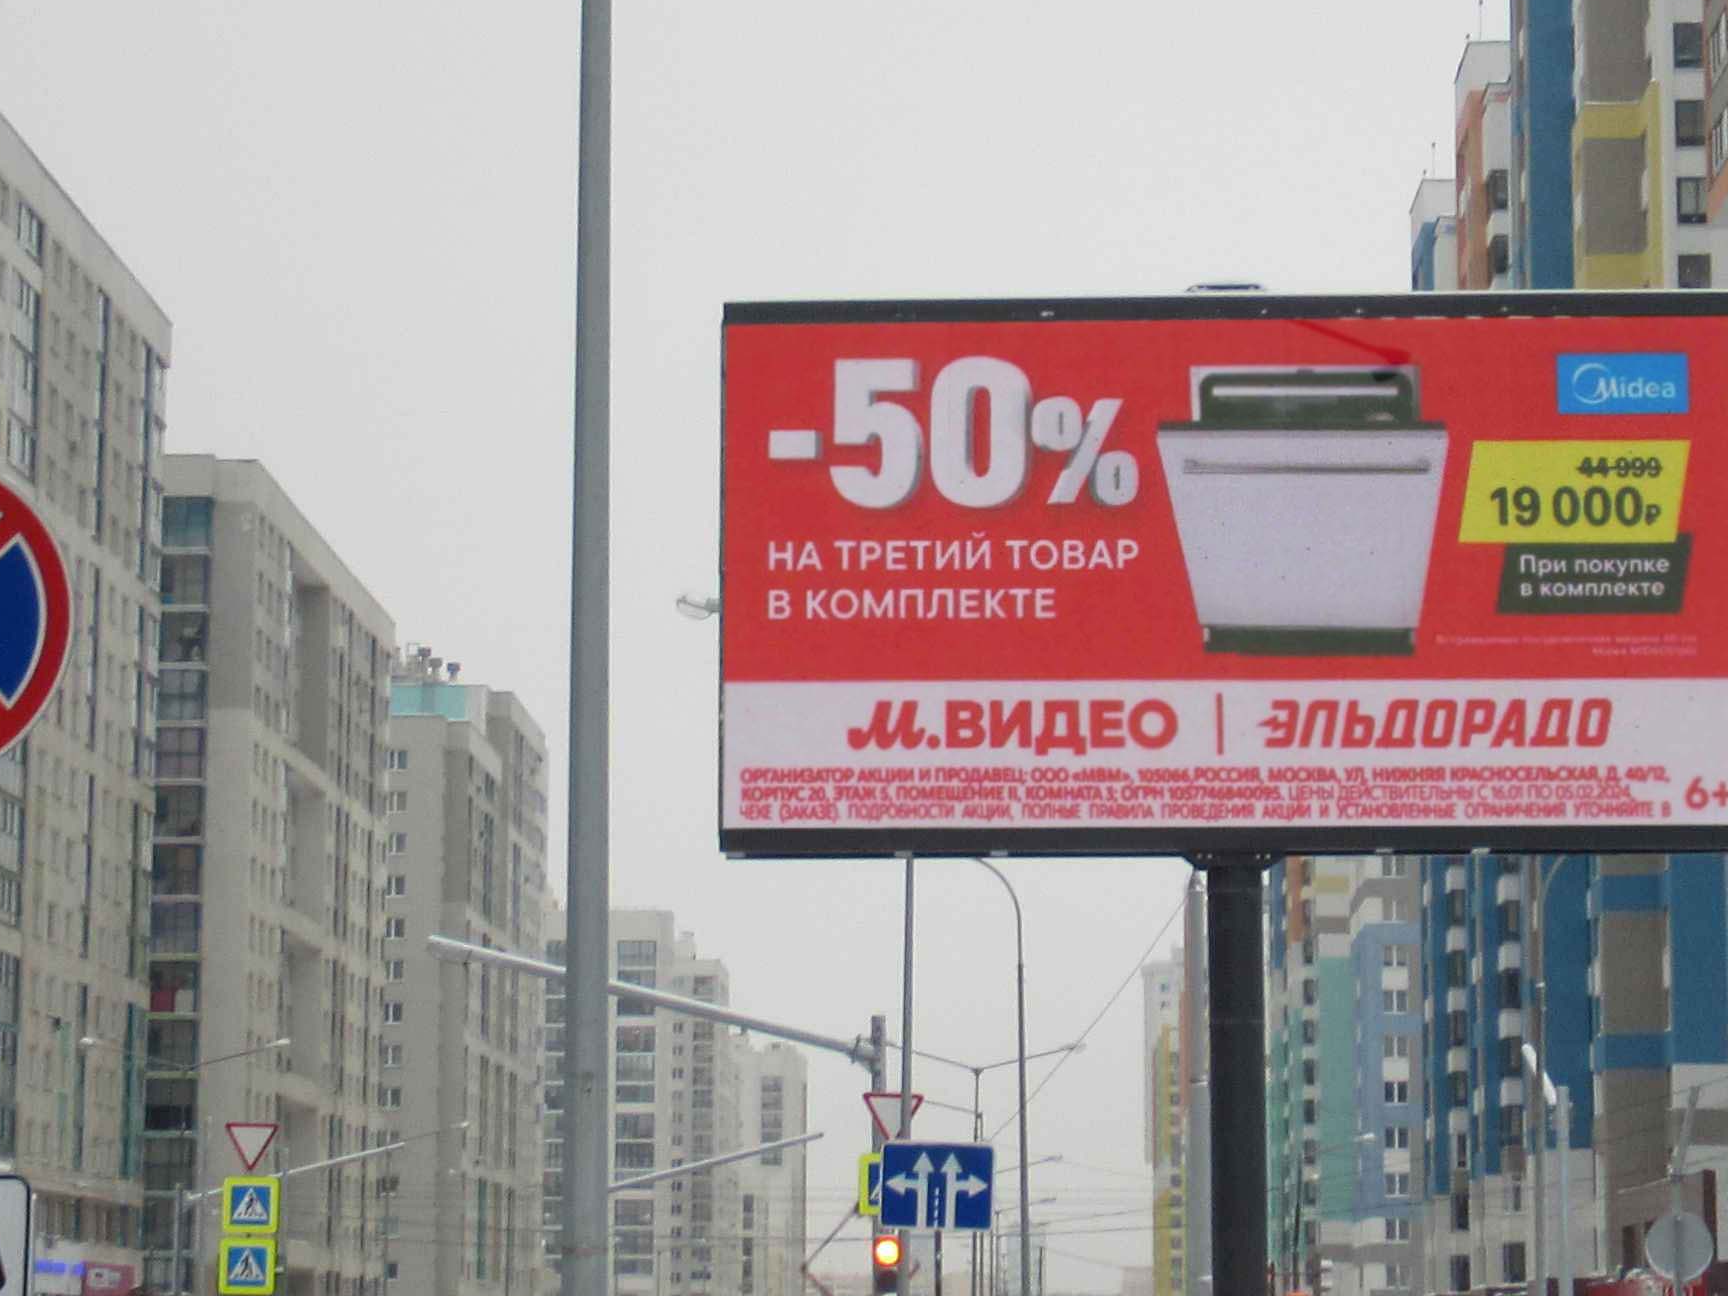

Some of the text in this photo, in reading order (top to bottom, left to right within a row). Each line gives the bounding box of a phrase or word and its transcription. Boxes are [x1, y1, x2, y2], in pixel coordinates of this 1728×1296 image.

[1590, 375, 1677, 401] Midea
[768, 355, 1140, 509] -50%
[768, 532, 1140, 571] НА ТРЕТИЙ ТОВАР
[1520, 555, 1670, 578] При покупке
[1519, 582, 1666, 598] в комплекте
[768, 587, 1057, 620] В КОМПЛЕКТЕ
[1255, 697, 1613, 750] ЭЛЬДОРАДО
[740, 767, 854, 783] ОРГАНИЗАТОР
[857, 767, 915, 786] АКЦИИ
[918, 767, 931, 783] И
[1030, 766, 1069, 783] ООО
[1268, 766, 1341, 784] МОСКВА,
[1373, 766, 1445, 782] НИЖНЯЯ
[1450, 765, 1602, 783] КРАСНОСЕЛЬСКАЯ,
[741, 785, 807, 801] КОРПУС
[832, 785, 876, 801] ЭТАЖ
[897, 785, 1003, 802] ПОМЕЩЕНИЕ
[1026, 785, 1102, 801] КОМНАТА
[1122, 785, 1164, 801] ОГРН
[1288, 784, 1333, 801] ЦЕНЫ
[1337, 784, 1472, 801] ДЕЙСТВИТЕЛЬНЫ
[1477, 784, 1489, 800] С
[1528, 784, 1552, 800] ПО
[740, 804, 771, 819] ЧЕКЕ
[848, 804, 954, 819] ПОДРОБНОСТИ
[1022, 803, 1081, 819] ПОЛНЫЕ
[1089, 803, 1154, 818] ПРАВИЛА
[1161, 803, 1255, 819] ПРОВЕДЕНИЯ
[1262, 803, 1311, 820] АКЦИИ
[1336, 802, 1456, 818] УСТАНОВЛЕННЫЕ
[1465, 802, 1565, 817] ОГРАНИЧЕНИЯ
[1574, 802, 1654, 817] УТОЧНЯЙТЕ
